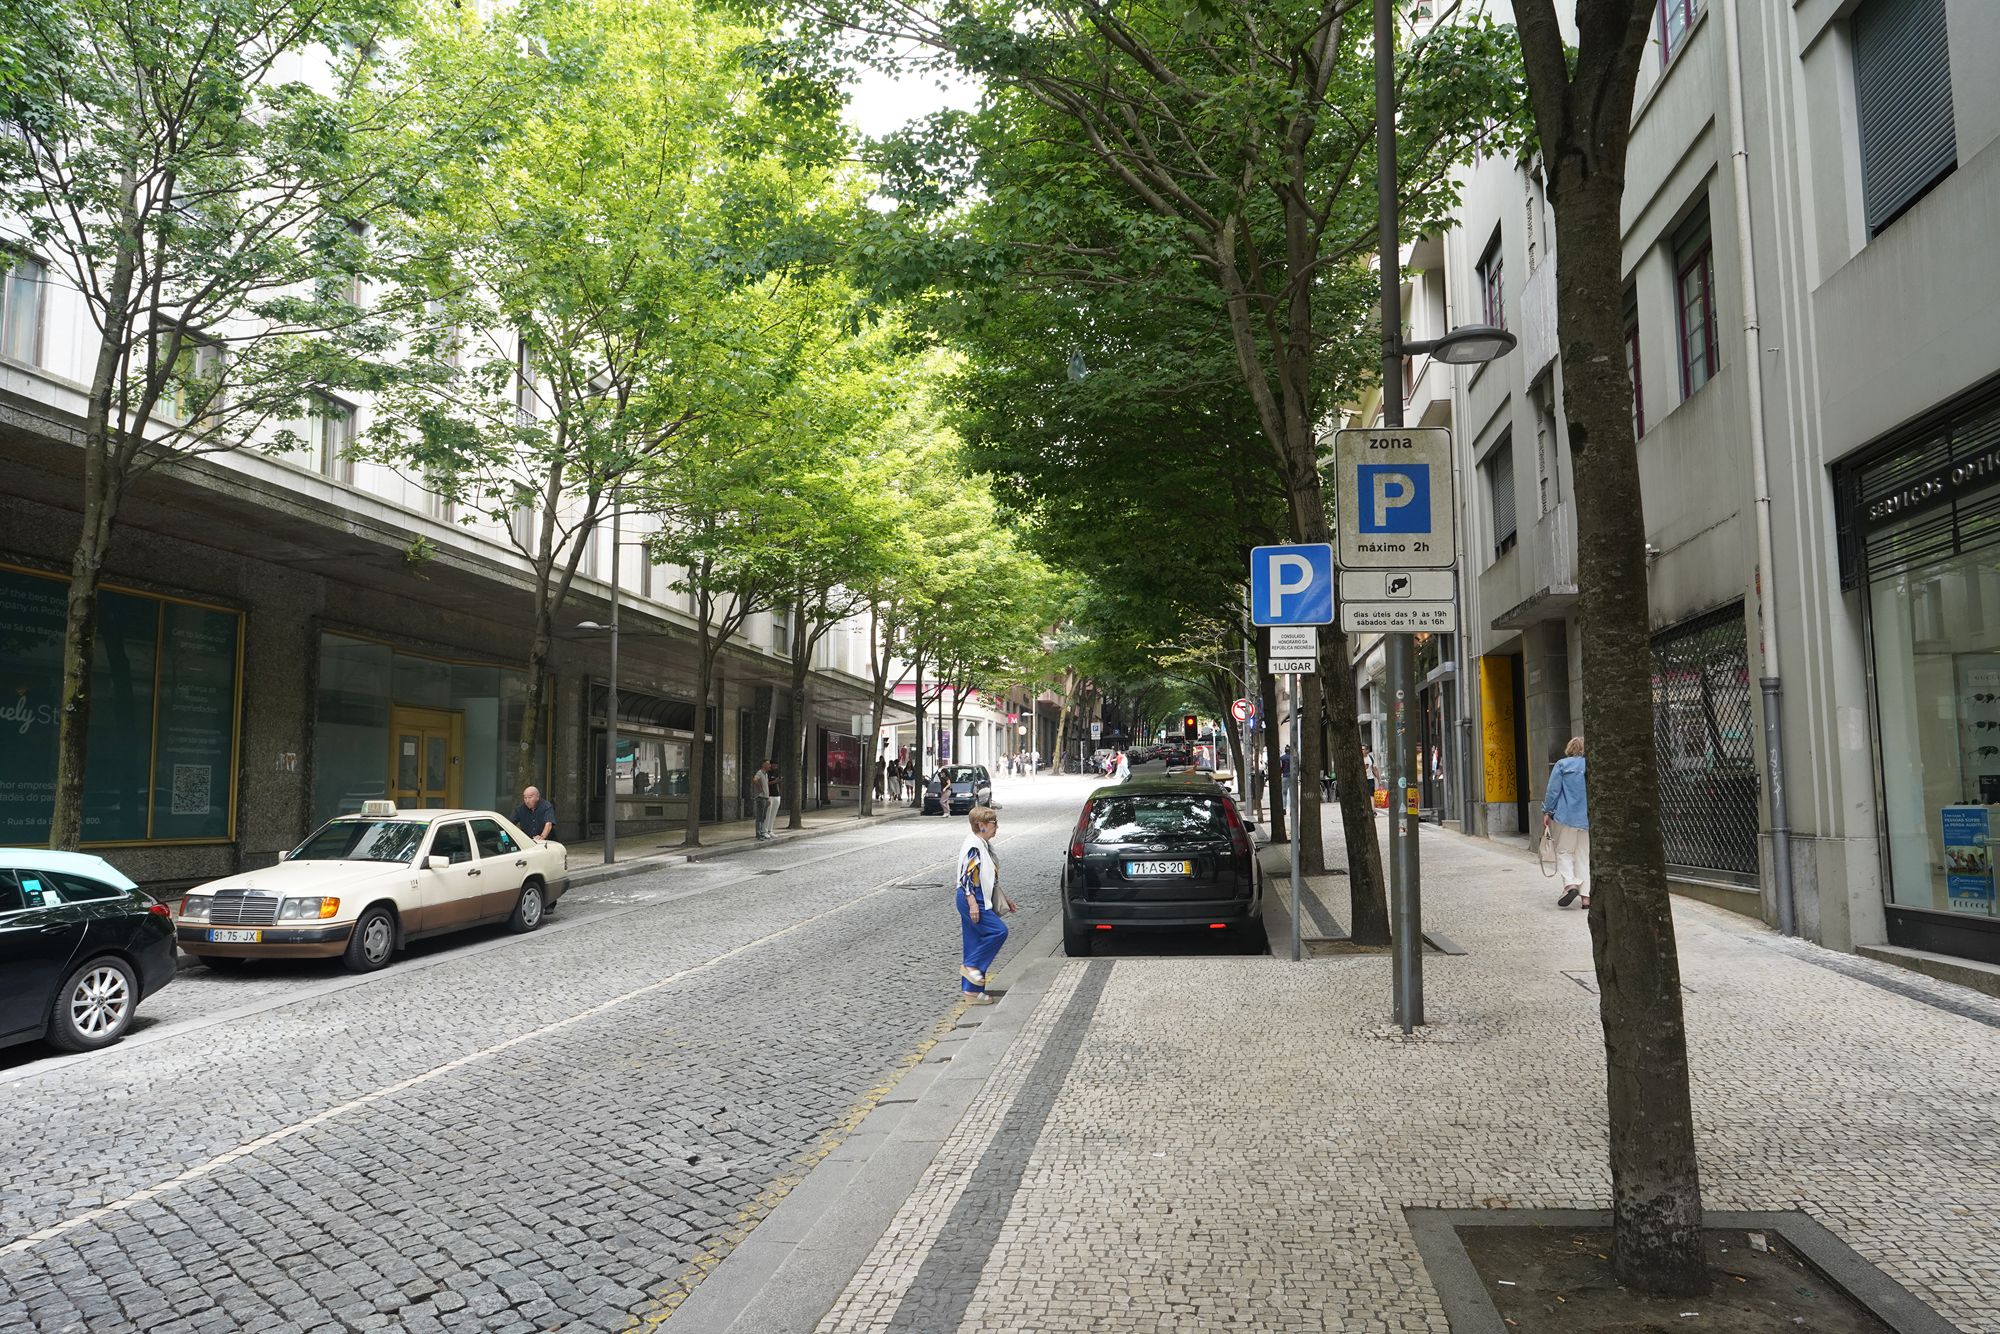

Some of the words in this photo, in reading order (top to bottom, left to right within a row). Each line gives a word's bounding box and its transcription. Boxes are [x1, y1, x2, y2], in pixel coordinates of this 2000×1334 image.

[1369, 437, 1413, 449] zona
[1373, 472, 1416, 527] P
[1869, 477, 1943, 520] SERVIÇOS
[1358, 542, 1406, 552] máximo
[1413, 542, 1430, 552] 2h
[1269, 554, 1314, 618] P
[1372, 610, 1391, 618] úteis
[26, 792, 38, 801] do
[7, 817, 24, 826] Rua
[36, 817, 47, 825] da
